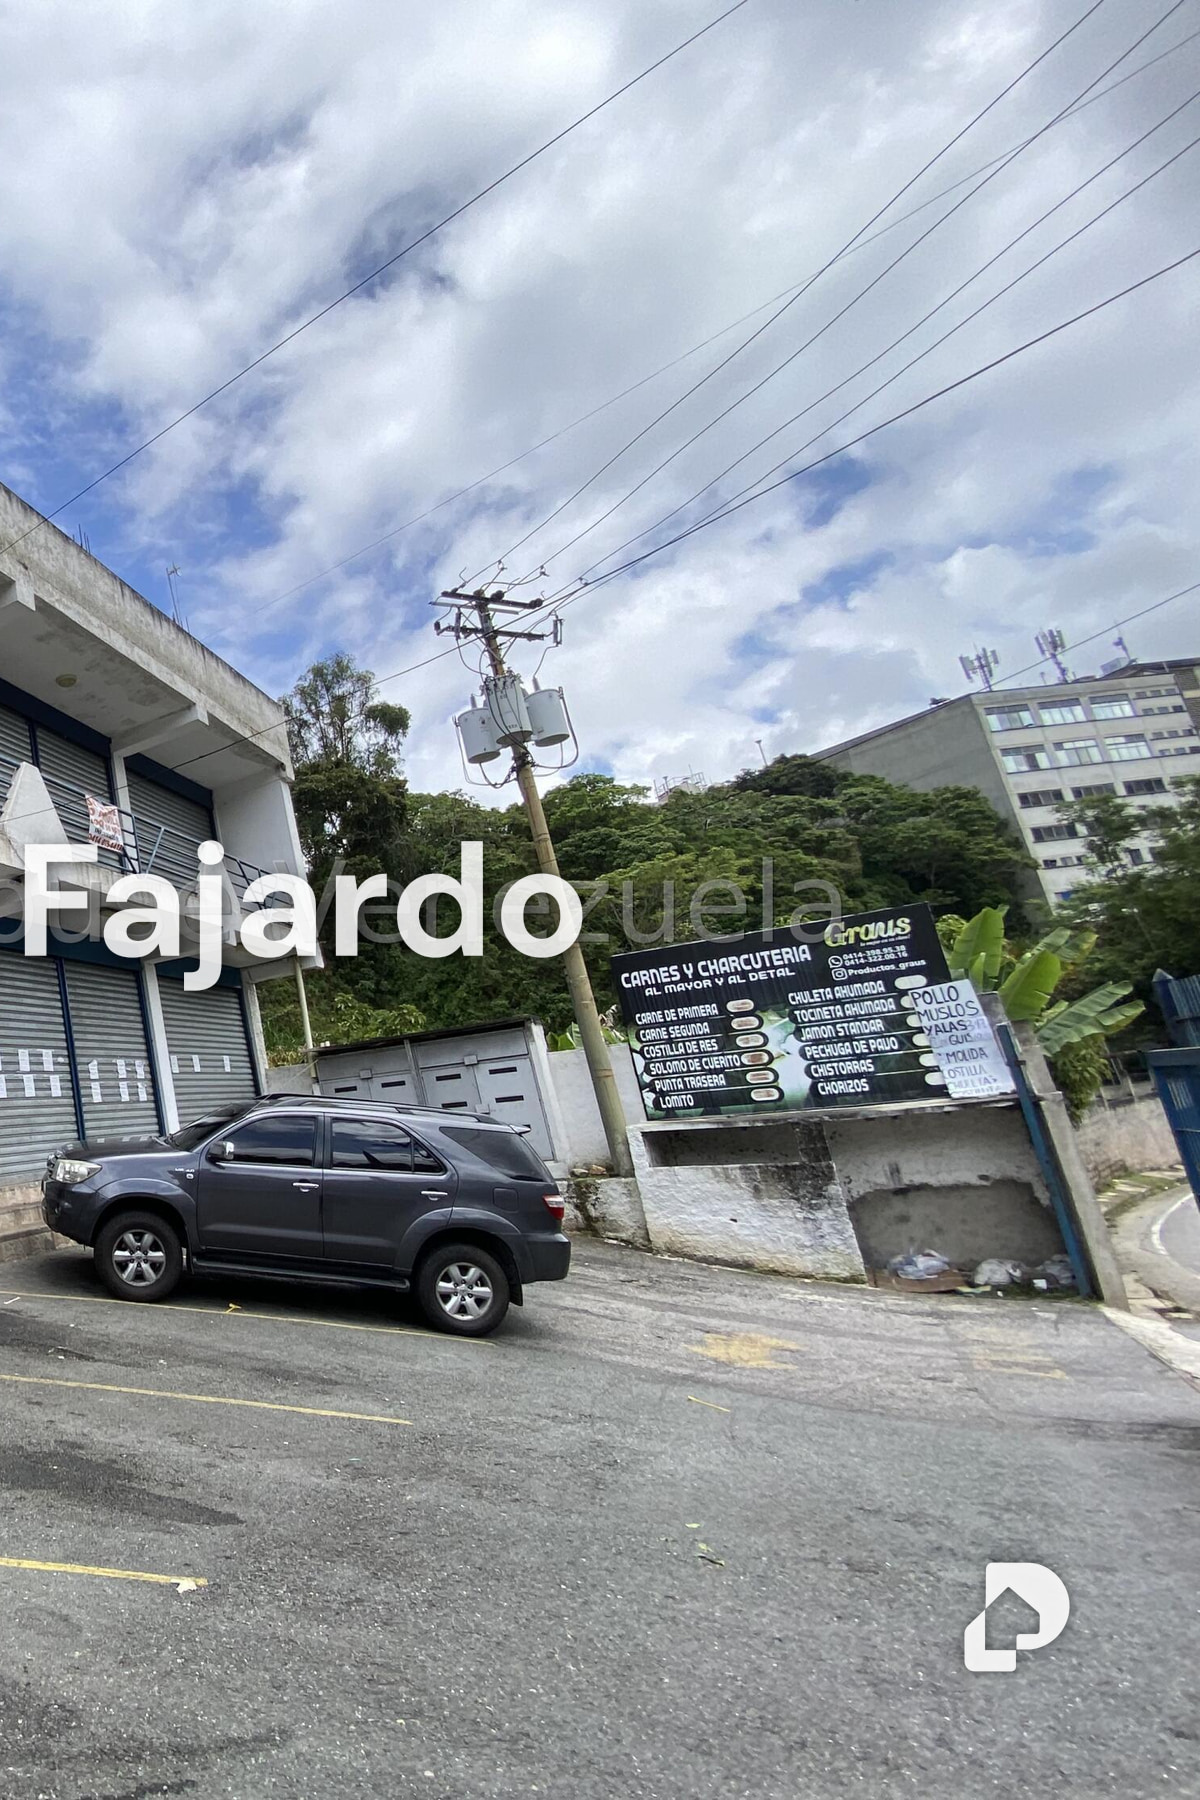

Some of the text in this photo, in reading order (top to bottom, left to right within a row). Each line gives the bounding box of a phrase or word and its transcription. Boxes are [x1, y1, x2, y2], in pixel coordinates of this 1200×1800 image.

[823, 917, 912, 948] Graus
[620, 944, 812, 989] CARNES Y CHARCUTERIA
[644, 967, 796, 997] AL MAYOR Y AL DETAL
[788, 980, 886, 1005] CHULETA AHUMADA
[910, 985, 959, 1008] POLLO
[635, 1003, 719, 1026] CARNE DE PRIMERA
[793, 998, 896, 1023] TOCINETA AHUMADA
[917, 1000, 980, 1023] MUSLOS
[639, 1022, 710, 1042] CARNE SEGUNDA
[800, 1019, 885, 1041] JAMON STANDAR
[644, 1038, 718, 1059] COSTILLA DE RES
[804, 1041, 853, 1059] PECHUGA
[853, 1040, 869, 1054] DE
[945, 1047, 989, 1064] MOLIDA
[649, 1054, 741, 1075] SOLOMO DE CUERITO
[810, 1059, 875, 1078] CHISTORRAS
[943, 1063, 988, 1080] OSTILLA
[654, 1073, 726, 1092] PUNTA TRASERA
[817, 1078, 870, 1096] CHORIZOS
[660, 1094, 695, 1109] LOMITO
